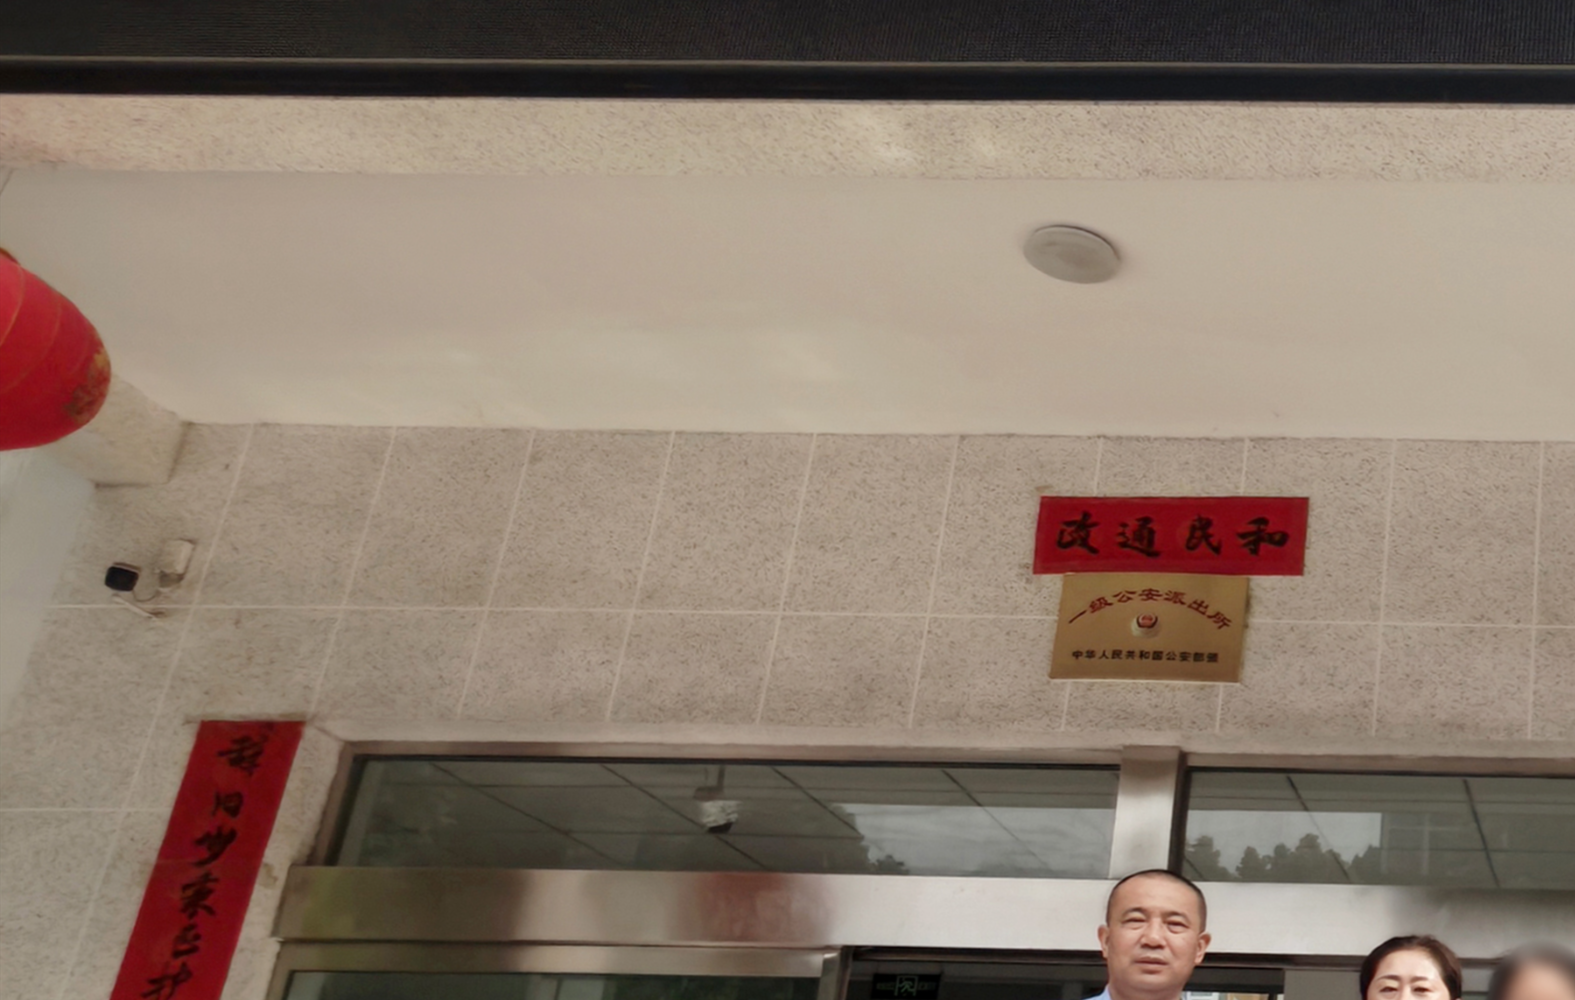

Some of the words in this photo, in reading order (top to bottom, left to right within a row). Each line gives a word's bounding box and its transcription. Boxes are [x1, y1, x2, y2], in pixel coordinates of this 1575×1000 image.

[1055, 511, 1290, 559] 政通民和
[1067, 588, 1233, 630] 一级公安派出所
